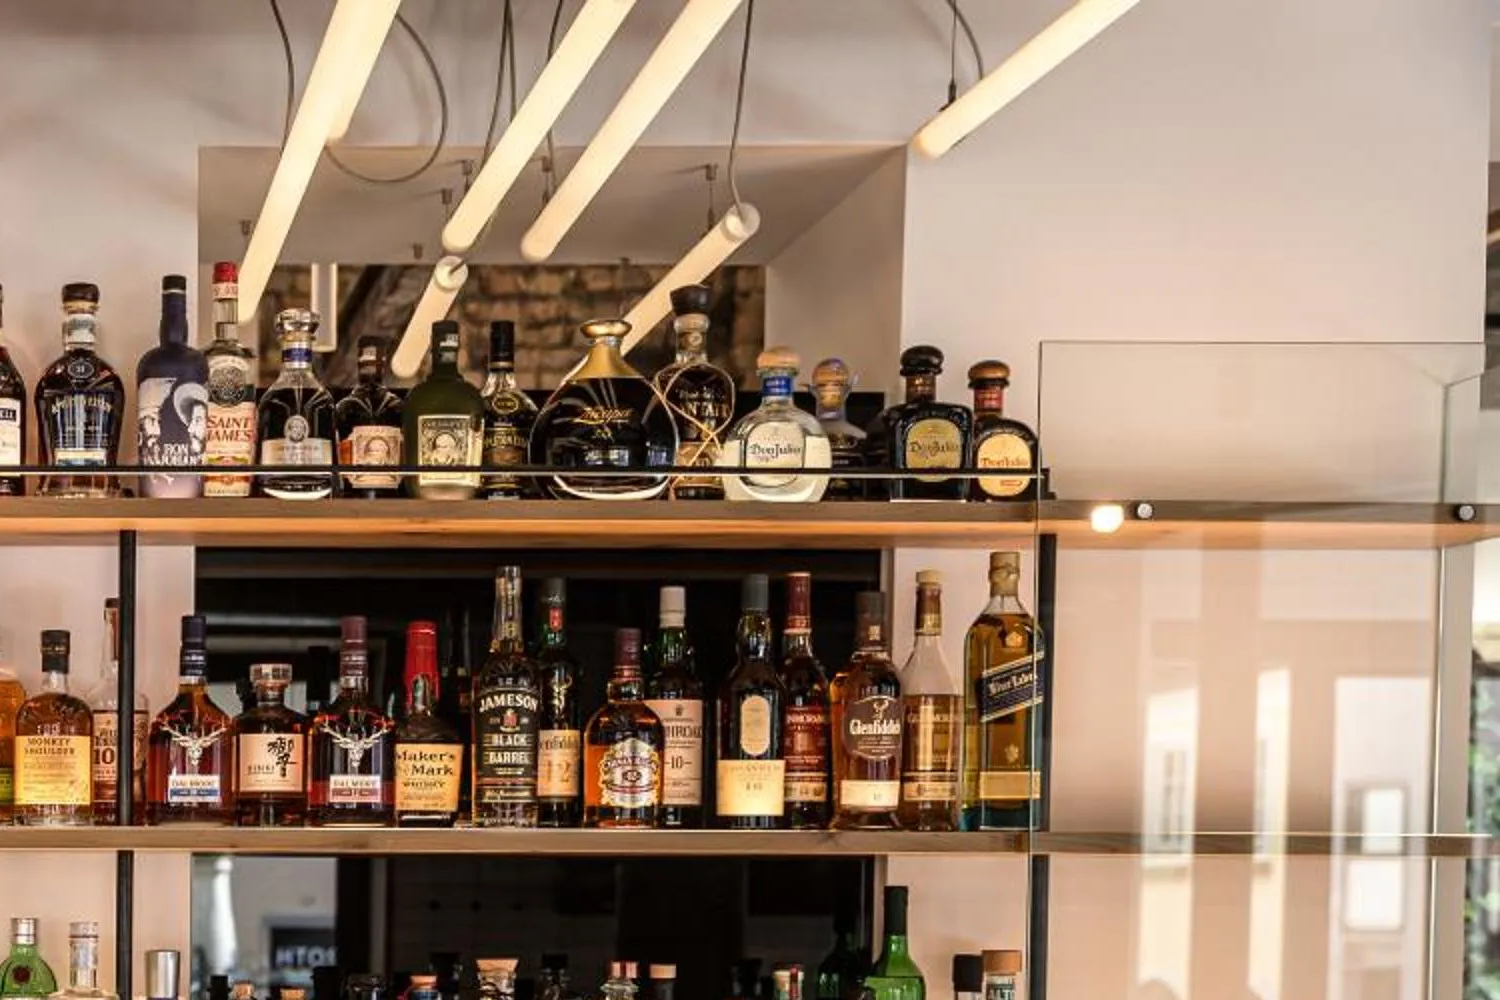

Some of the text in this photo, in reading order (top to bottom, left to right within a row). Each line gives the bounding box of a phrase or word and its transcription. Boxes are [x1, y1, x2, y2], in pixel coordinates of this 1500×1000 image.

[207, 415, 252, 428] SAINT
[207, 429, 253, 442] JAMES
[479, 693, 538, 713] JAMESON
[27, 737, 70, 746] MONKEY
[490, 733, 528, 746] BLACK
[93, 747, 115, 765] 10
[396, 748, 456, 762] Maker's
[489, 751, 530, 764] BARREL
[410, 763, 454, 776] Mark
